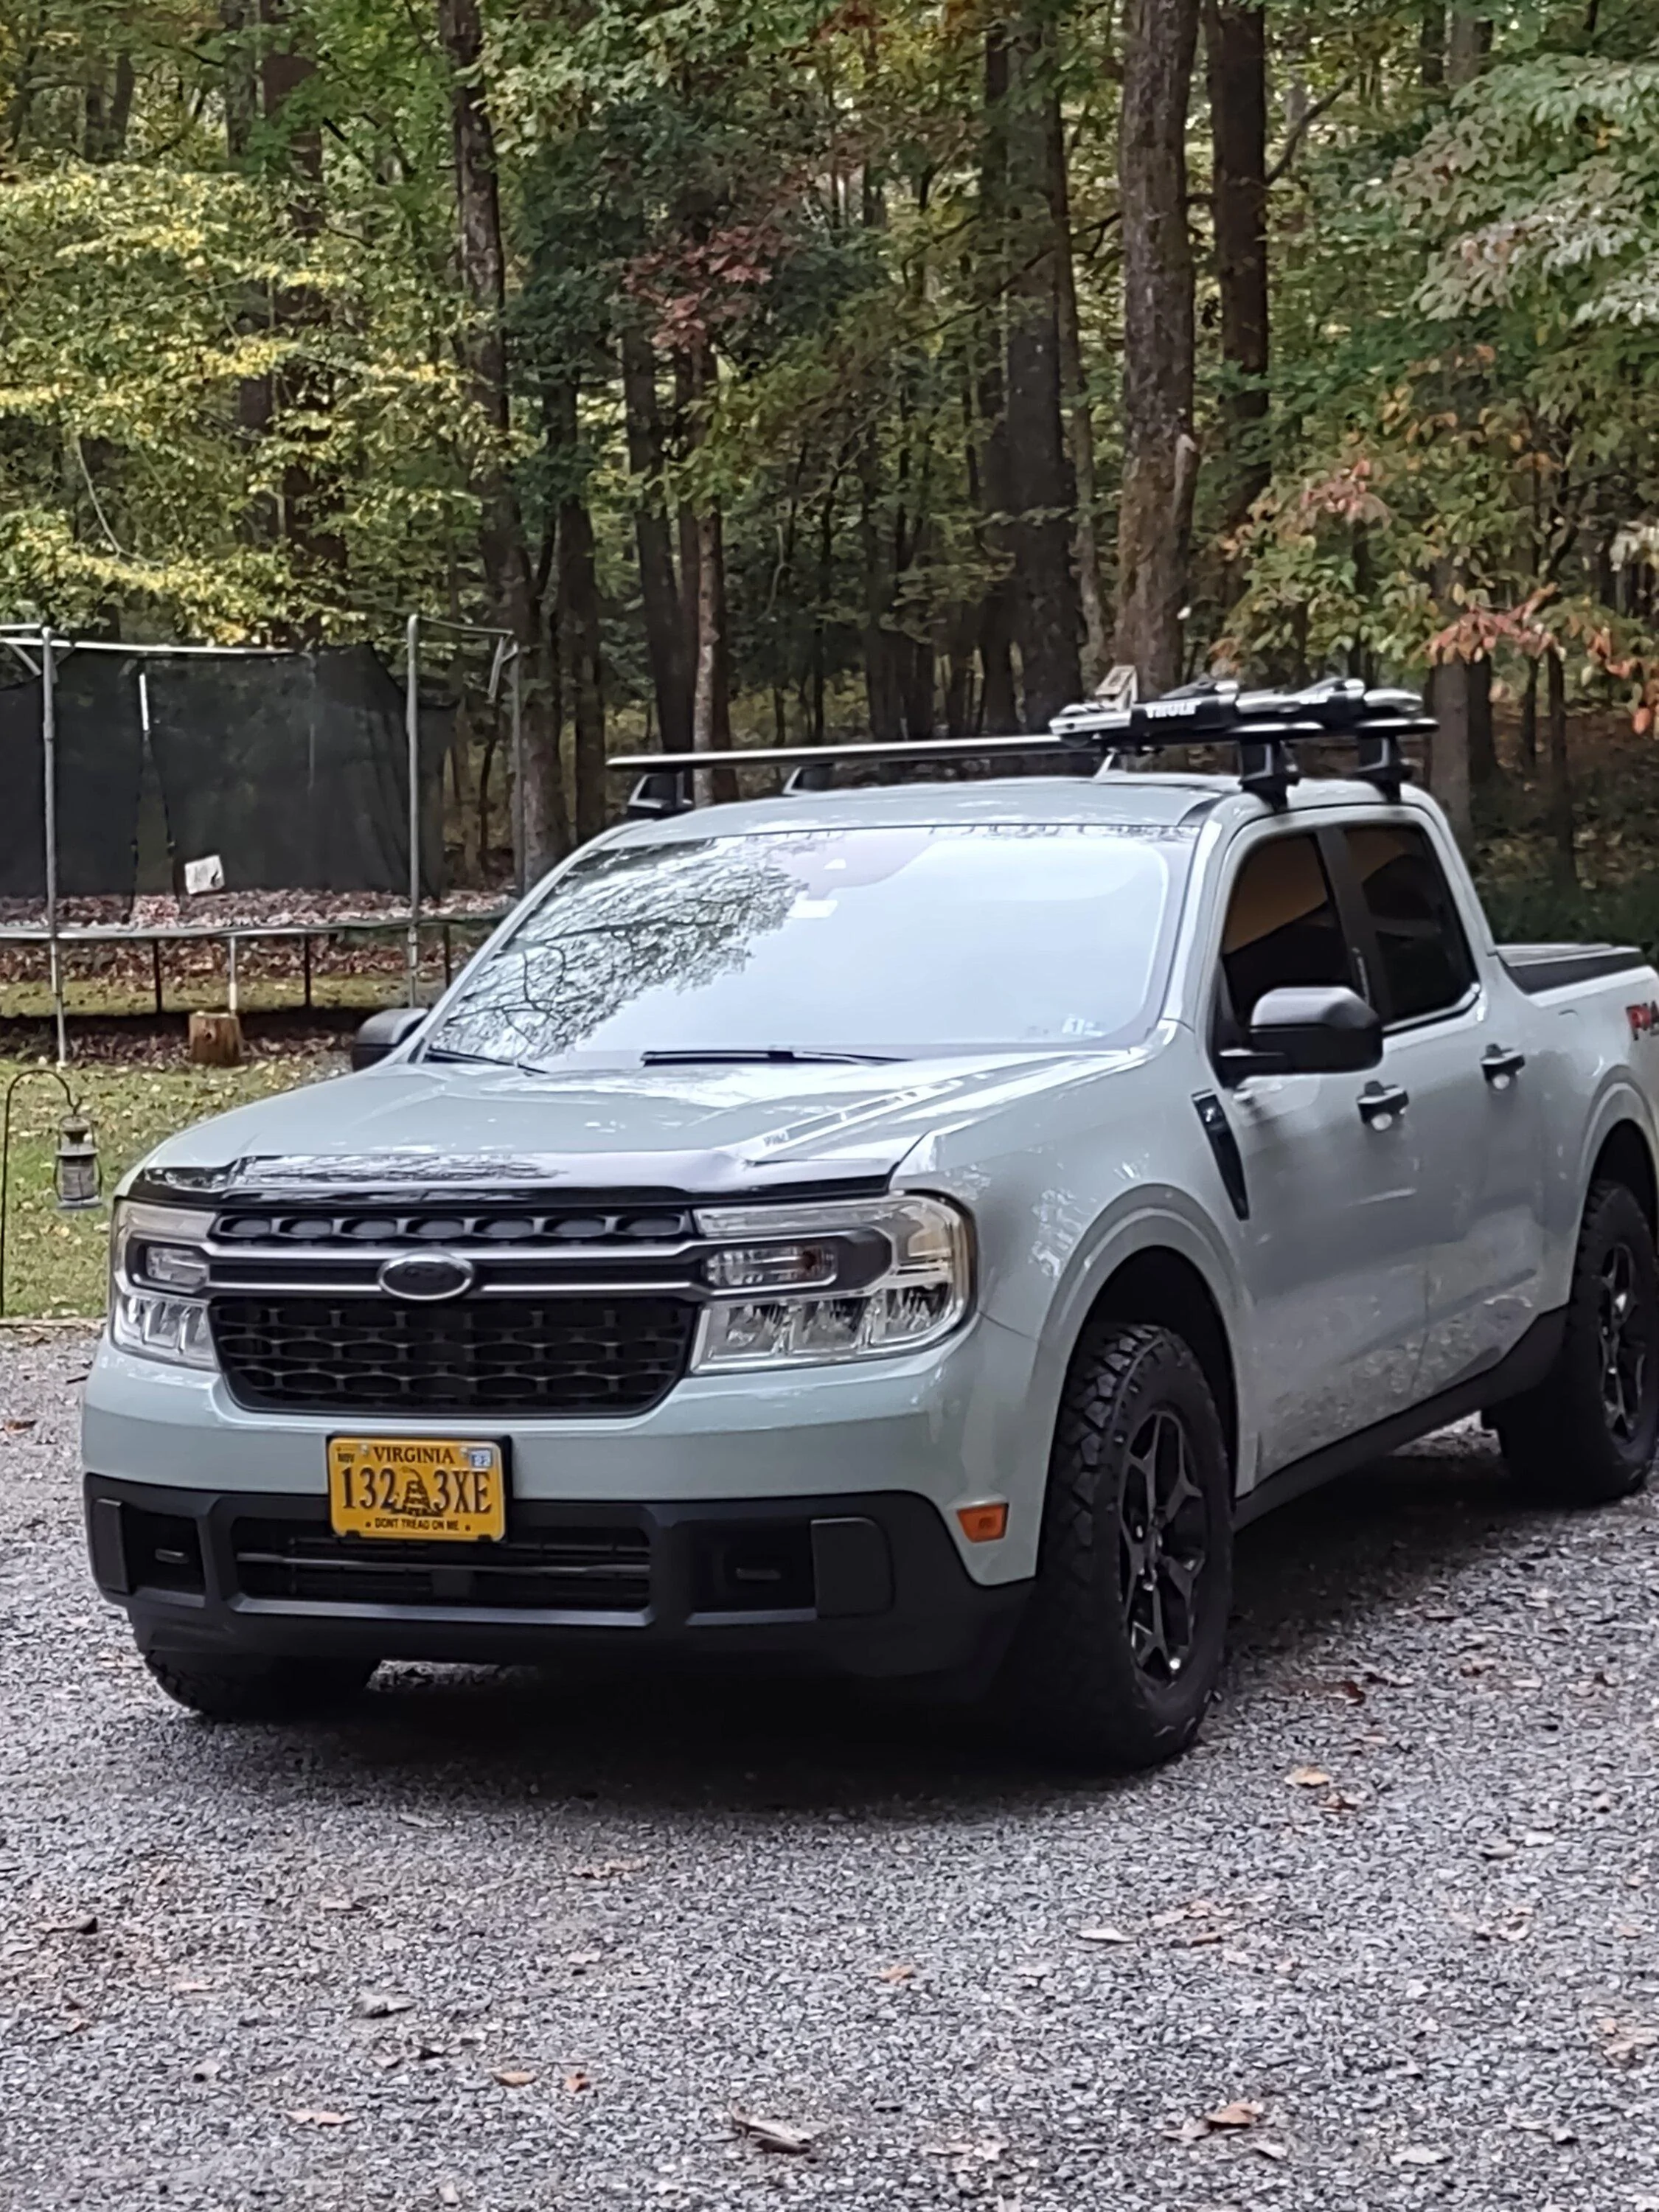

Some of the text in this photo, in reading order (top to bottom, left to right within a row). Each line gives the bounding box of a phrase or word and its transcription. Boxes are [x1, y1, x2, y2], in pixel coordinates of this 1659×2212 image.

[373, 1446, 455, 1464] VIRGINIA
[341, 1467, 492, 1514] 132 3XE
[401, 1518, 430, 1530] TREAD
[432, 1520, 444, 1530] ON
[447, 1520, 459, 1531] ME
